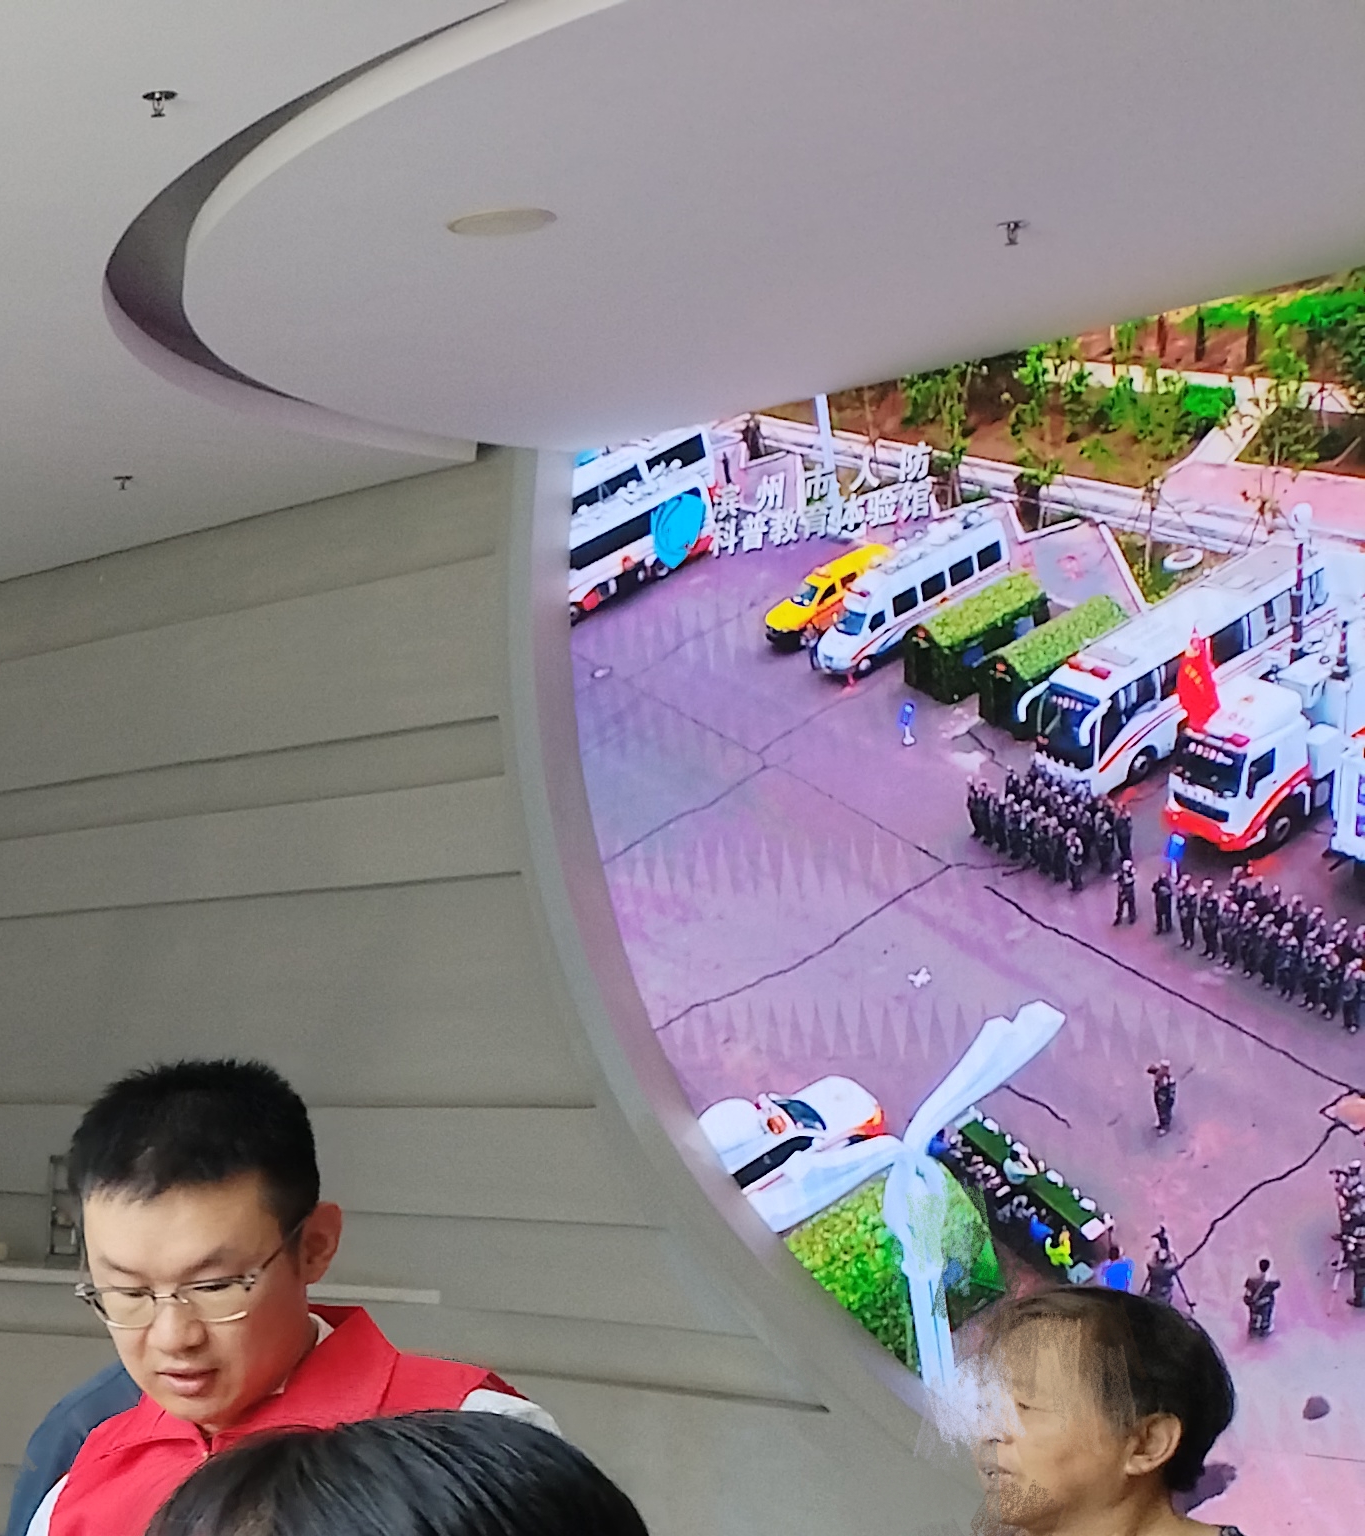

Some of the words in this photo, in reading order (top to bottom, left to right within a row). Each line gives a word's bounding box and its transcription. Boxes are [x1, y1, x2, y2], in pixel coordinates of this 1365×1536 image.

[713, 441, 933, 518] 滨州市人防
[712, 480, 933, 558] 科普教育体验馆
